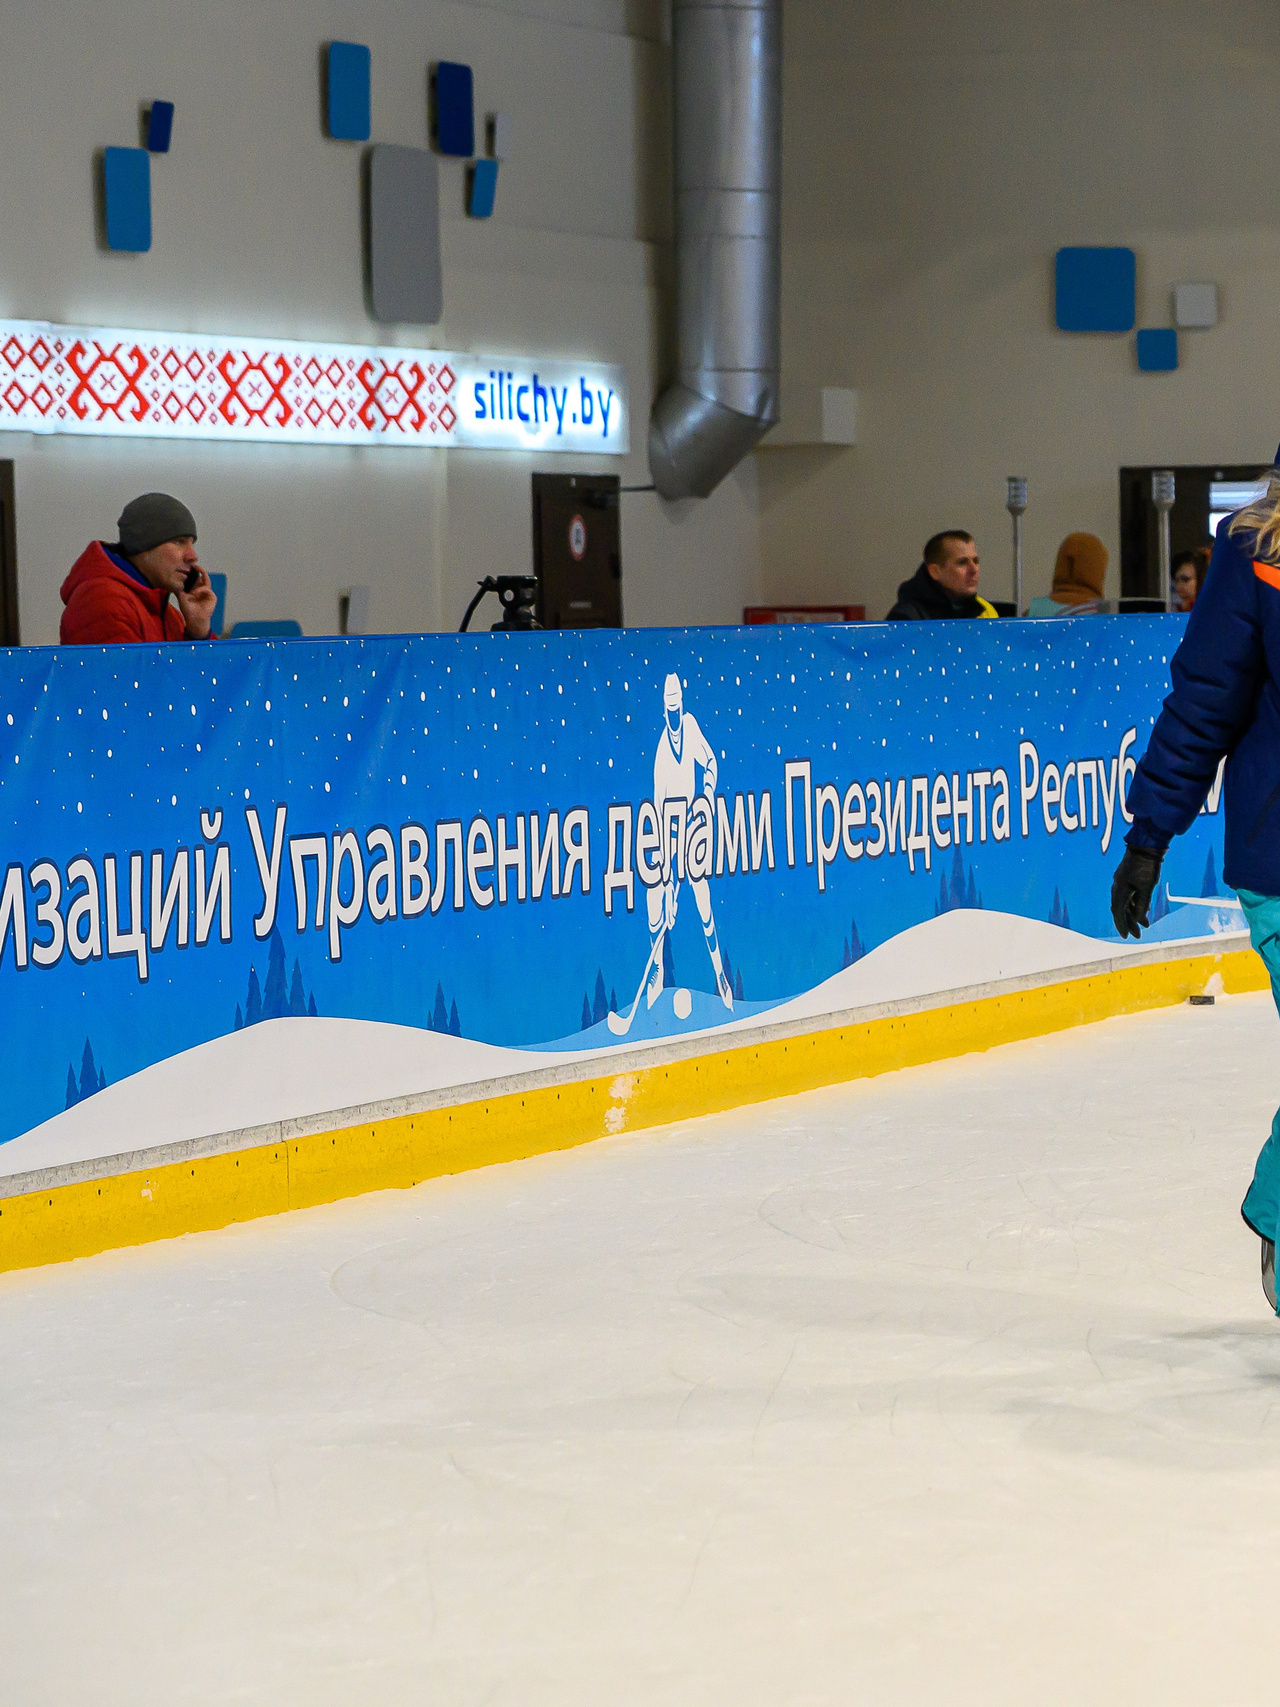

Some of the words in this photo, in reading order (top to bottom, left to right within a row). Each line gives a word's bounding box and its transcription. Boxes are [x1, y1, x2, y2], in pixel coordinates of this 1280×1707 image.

[474, 369, 613, 437] silichy.by
[245, 802, 591, 962] Управления
[605, 792, 775, 914] делами
[785, 759, 1010, 892] Президента
[1019, 727, 1138, 854] Респуб
